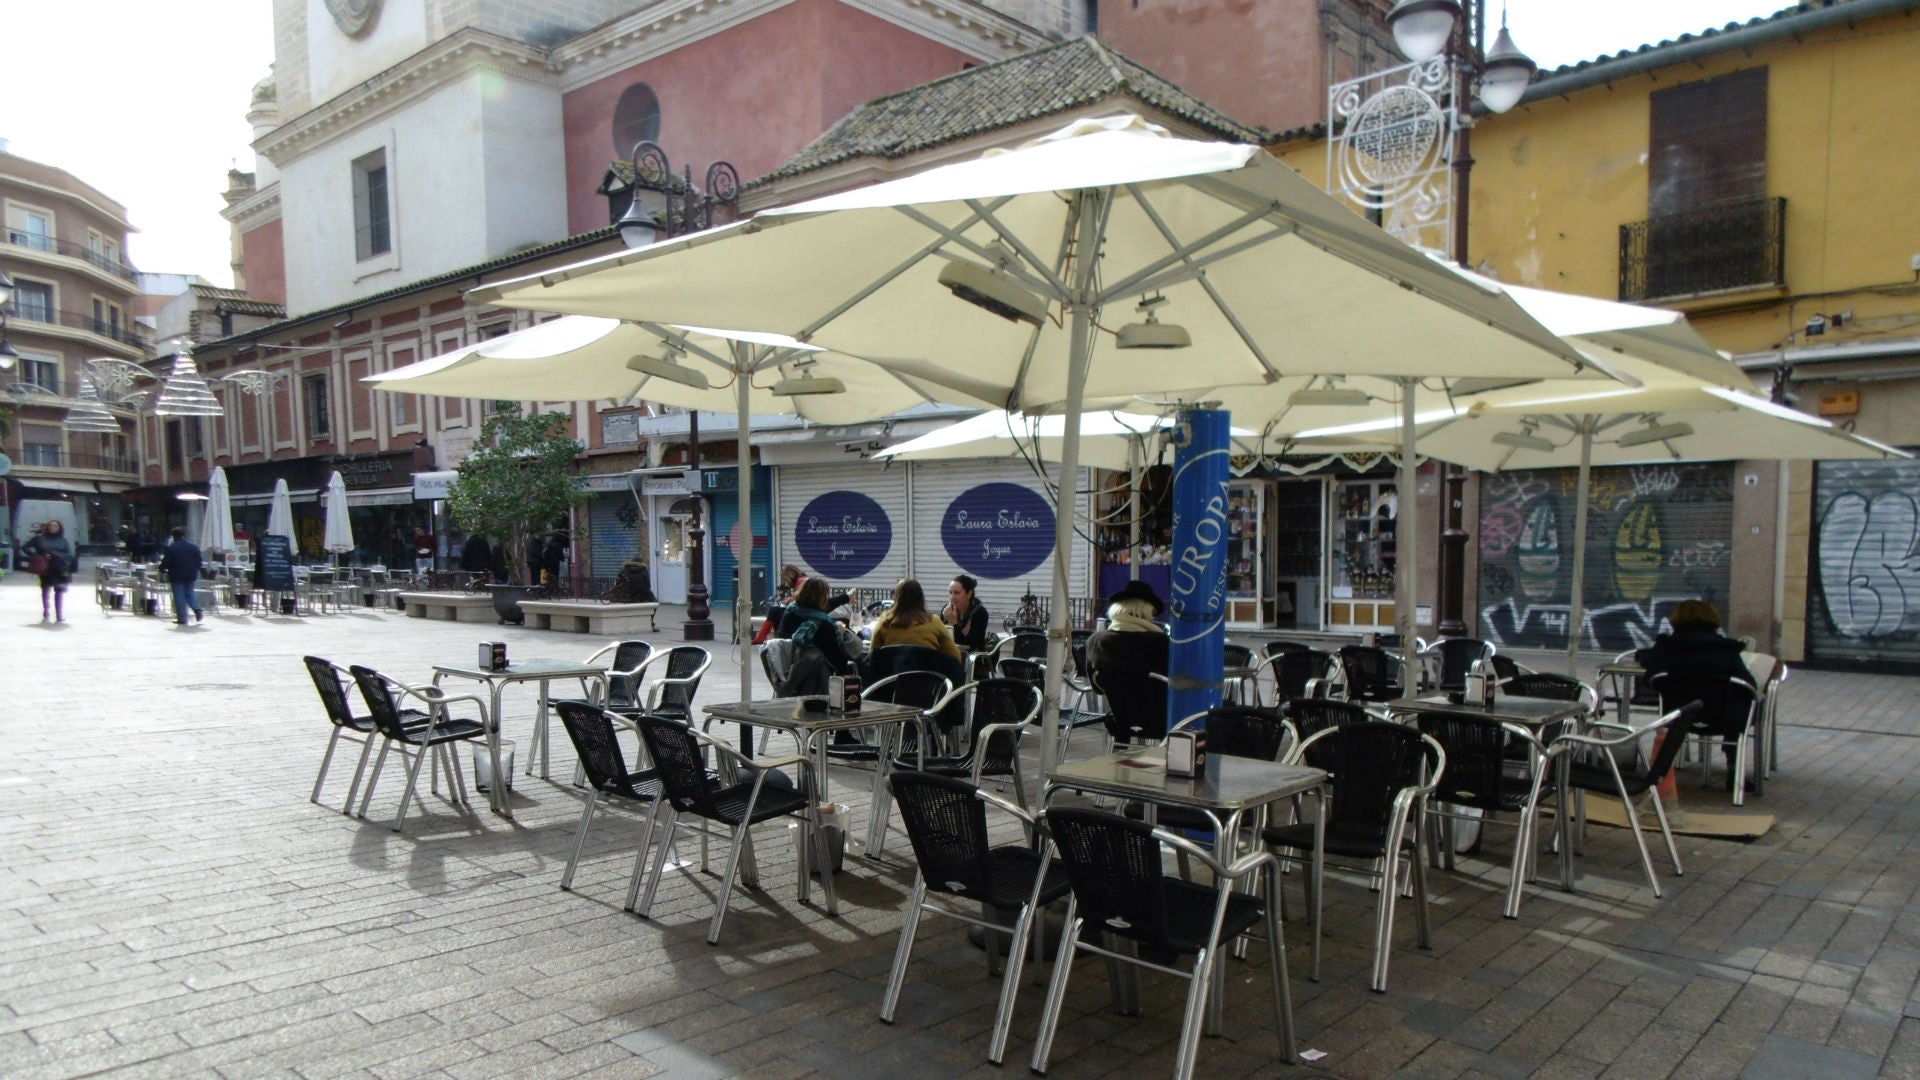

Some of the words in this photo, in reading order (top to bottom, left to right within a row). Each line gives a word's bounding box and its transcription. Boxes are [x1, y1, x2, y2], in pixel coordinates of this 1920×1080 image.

[807, 516, 839, 534] Laura
[842, 515, 878, 533] Eslava
[955, 510, 993, 529] Laura
[997, 509, 1040, 528] Eslava
[830, 541, 855, 560] Joyas
[982, 538, 1012, 559] Joyas
